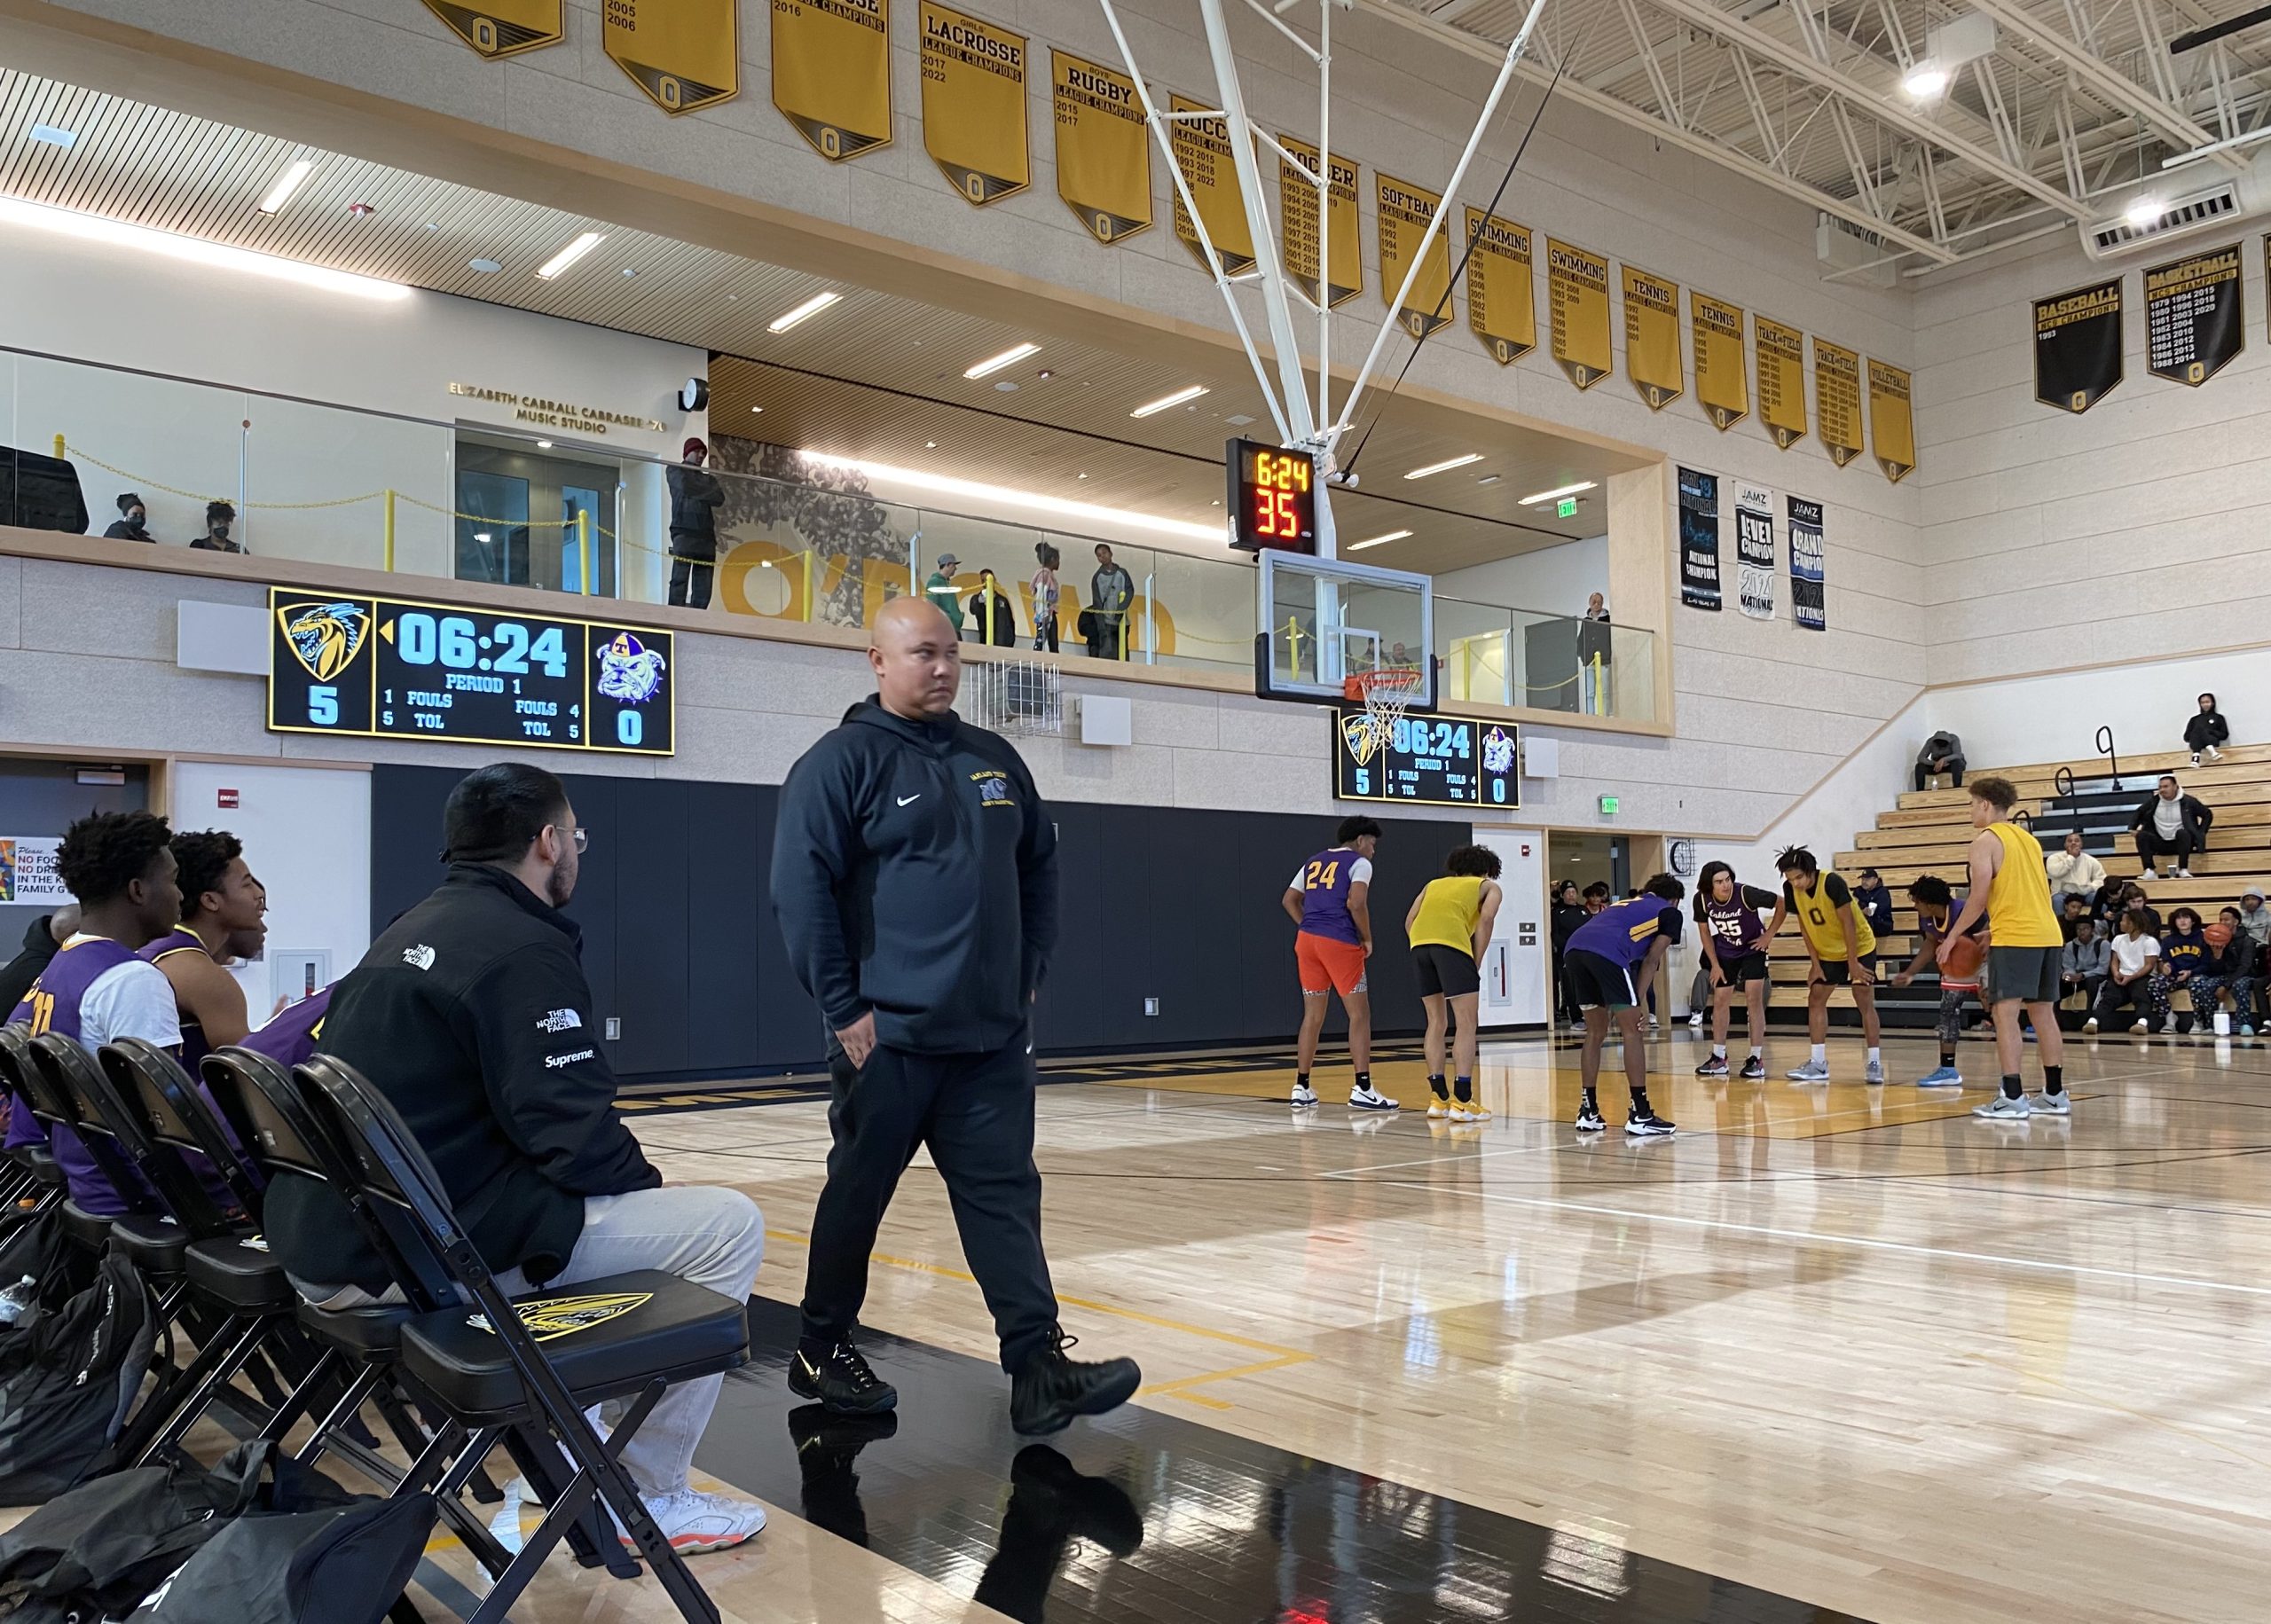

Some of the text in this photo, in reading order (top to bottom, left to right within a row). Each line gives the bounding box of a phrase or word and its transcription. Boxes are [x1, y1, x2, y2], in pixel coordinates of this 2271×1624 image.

[607, 0, 636, 17] 2005
[774, 0, 801, 17] 2016
[607, 12, 636, 32] 2006
[927, 15, 1021, 67] LACROSSE
[923, 54, 946, 69] 2017
[924, 37, 1020, 82] LEAGUE CHAMPIONS
[923, 67, 946, 82] 2022
[1067, 67, 1132, 106] RUGBY
[1057, 85, 1143, 124] LEAGUE CHAMPIONS
[1057, 100, 1078, 115] 2015
[1057, 113, 1078, 127] 2017
[1177, 107, 1231, 143] SOCC
[1175, 129, 1208, 148] LEAGUE
[1175, 143, 1194, 156] 1992
[1197, 151, 1214, 164] 2015
[1197, 161, 1214, 176] 2018
[1285, 148, 1354, 187] OCER
[1197, 174, 1215, 187] 2022
[1284, 182, 1319, 200] 1993 2004
[1284, 192, 1319, 212] 1994 2006
[1382, 185, 1444, 222] SOFTBAL
[1284, 204, 1319, 222] 1995 2007
[1178, 224, 1195, 238] 2010
[1285, 226, 1319, 244] 1997 2012
[1303, 222, 1318, 232] 2011
[1303, 243, 1320, 255] 2013
[1304, 265, 1320, 278] 2017
[1552, 249, 1604, 281] SWIMMING
[2147, 252, 2238, 290] BASKETBALL
[1632, 279, 1670, 303] TENNIS
[2152, 271, 2235, 300] NCS CHAMPIONS
[2038, 286, 2118, 322] BASEBALL
[2150, 286, 2215, 310] 1979 1994 2015
[2194, 294, 2215, 306] 2018
[1701, 304, 1735, 327] TENNIS
[2061, 304, 2117, 325] CHAMPIONS
[2172, 310, 2193, 321] 2003
[2194, 303, 2215, 315] 2020
[2173, 318, 2193, 330] 2004
[2173, 327, 2194, 339] 2010
[1758, 326, 1777, 344] TRACK
[1783, 335, 1801, 352] FIELD
[2173, 335, 2194, 347] 2012
[2174, 344, 2195, 356] 2013
[2174, 353, 2196, 365] 2014
[449, 381, 517, 404] ELZABETH
[522, 396, 578, 416] CABRALL
[516, 409, 607, 435] MUSIC STUDIO
[1257, 452, 1308, 492] 6:24
[1741, 489, 1767, 505] JAMZ
[1256, 488, 1296, 537] 35
[1795, 502, 1819, 518] JAMZ
[397, 612, 567, 678] 06:24
[444, 673, 522, 694] PERIOD 1
[308, 686, 339, 726] 5
[384, 689, 453, 709] 1 FOULS
[515, 699, 579, 718] FOULS 4
[382, 711, 445, 729] 5 TOL
[618, 710, 642, 745] 0
[523, 721, 579, 739] TOL 5
[1395, 718, 1470, 758] 06:24
[1415, 758, 1450, 771] PERIOD 1
[1356, 768, 1370, 795] 5
[1388, 770, 1419, 781] 1 FOULS
[1446, 773, 1476, 785] FOULS 4
[1387, 783, 1416, 796] 5 TOL
[1450, 788, 1476, 799] TOL 5
[1493, 778, 1505, 803] 0
[1306, 860, 1340, 890] 24
[1808, 908, 1826, 926] 0
[1716, 920, 1742, 937] 25
[536, 1016, 567, 1029] NORTH
[546, 1009, 565, 1018] THE
[546, 1022, 570, 1033] FACE
[545, 1049, 593, 1069] Supreme
